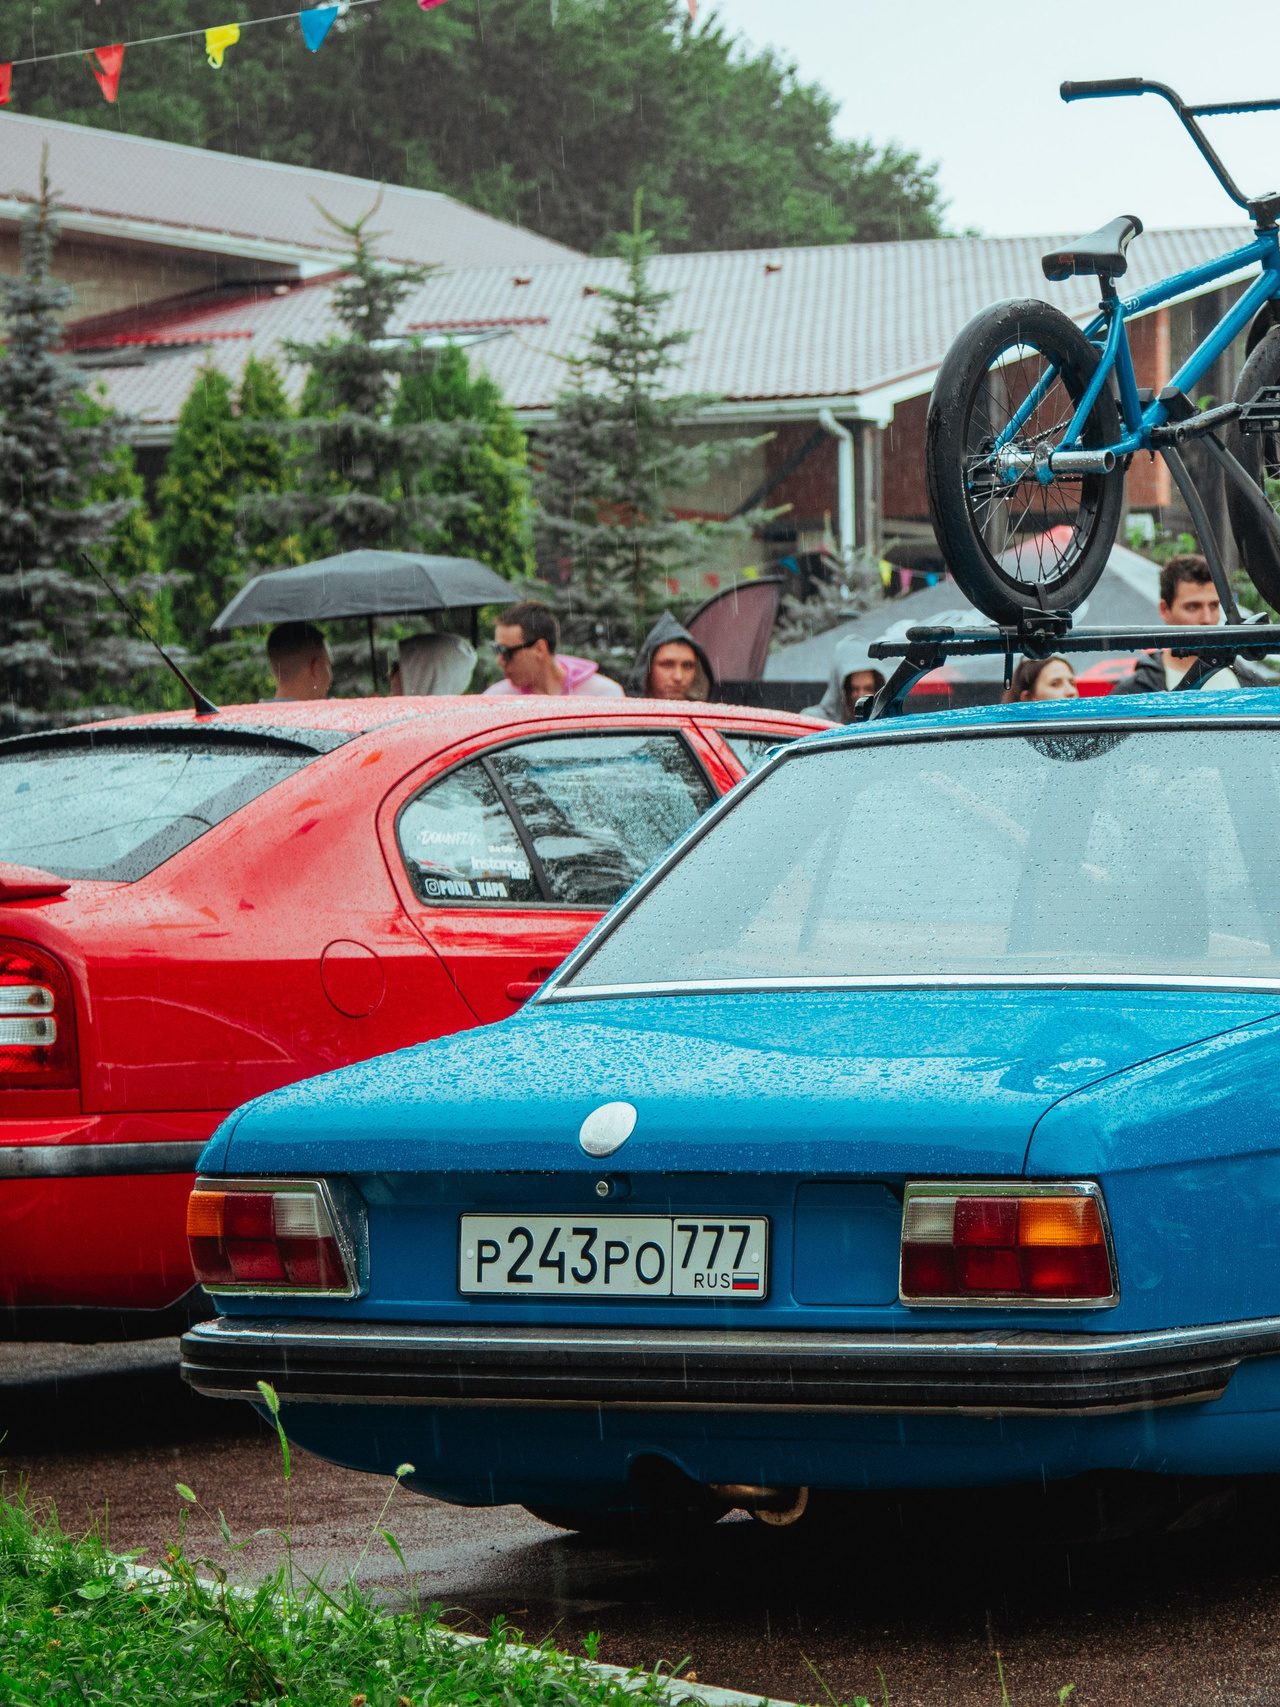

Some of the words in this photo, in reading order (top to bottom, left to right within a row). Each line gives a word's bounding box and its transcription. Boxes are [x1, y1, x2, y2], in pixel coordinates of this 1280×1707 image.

[476, 1226, 665, 1284] P243PO
[676, 1224, 751, 1269] 777
[694, 1273, 730, 1288] RUS
